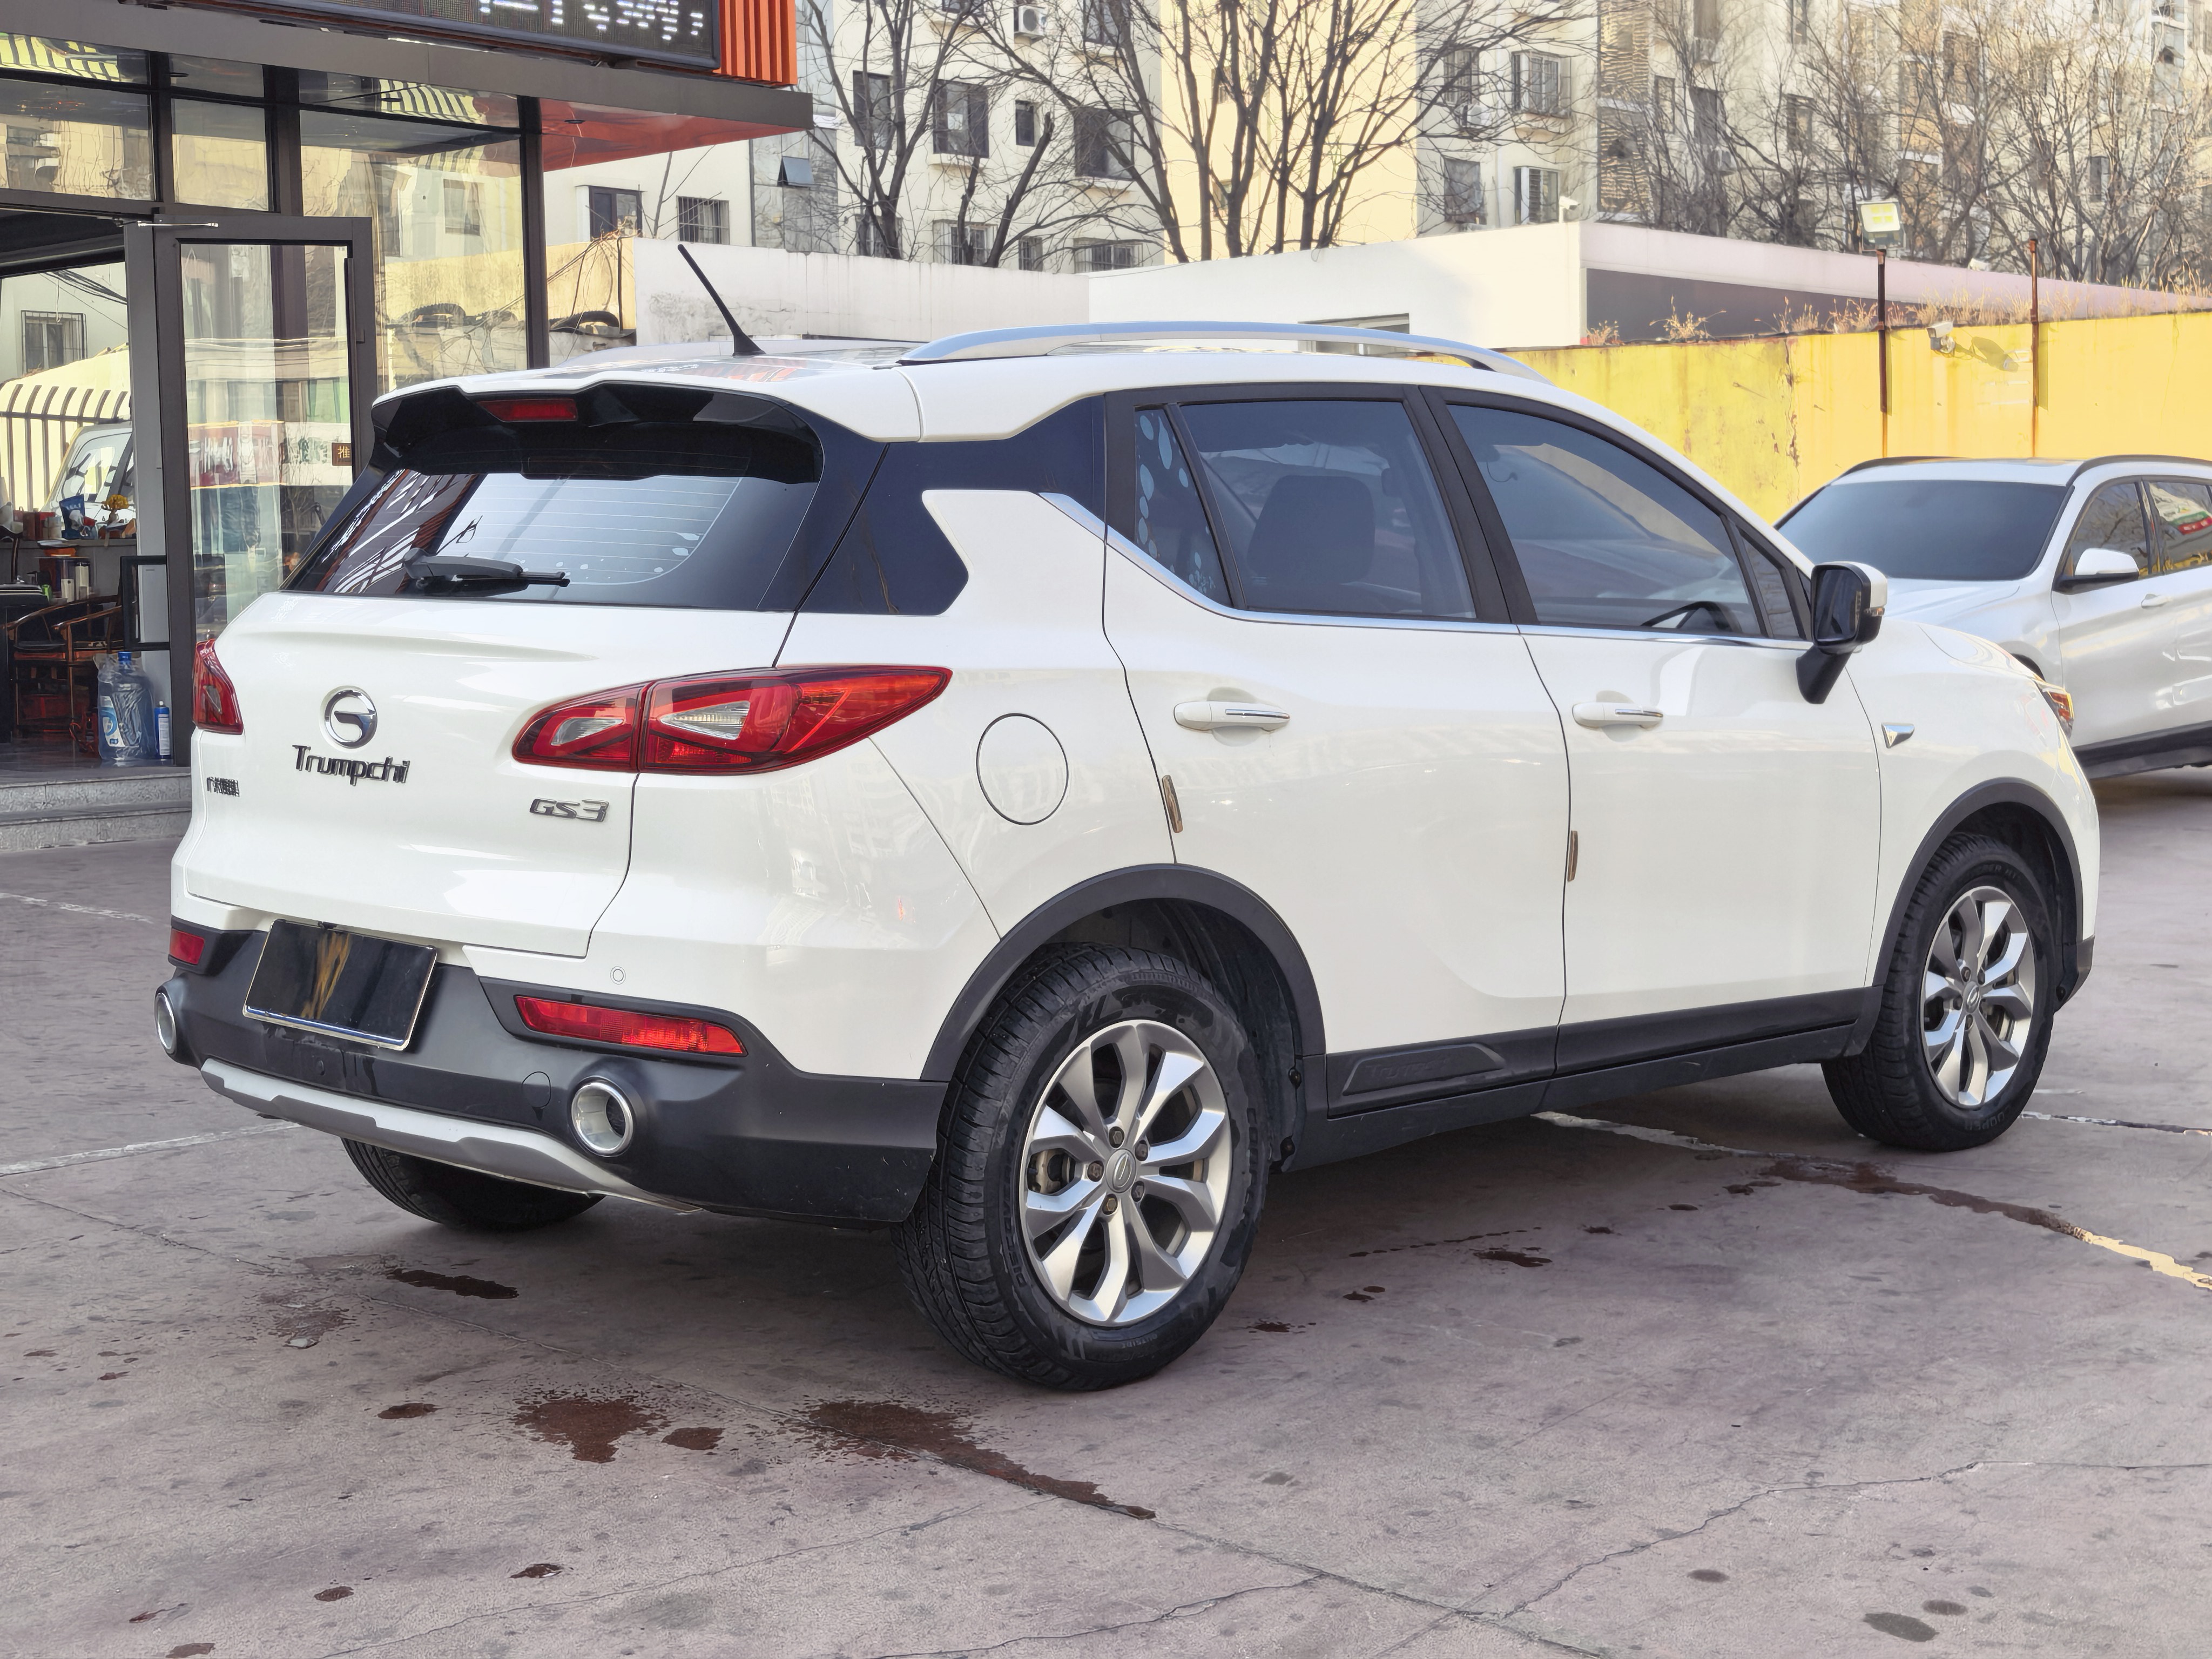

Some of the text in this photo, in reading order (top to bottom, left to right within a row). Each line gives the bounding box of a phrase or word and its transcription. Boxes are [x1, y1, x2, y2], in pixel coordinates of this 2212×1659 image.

[337, 446, 350, 458] 推
[292, 745, 410, 786] Trumpchi
[529, 797, 609, 822] GS3
